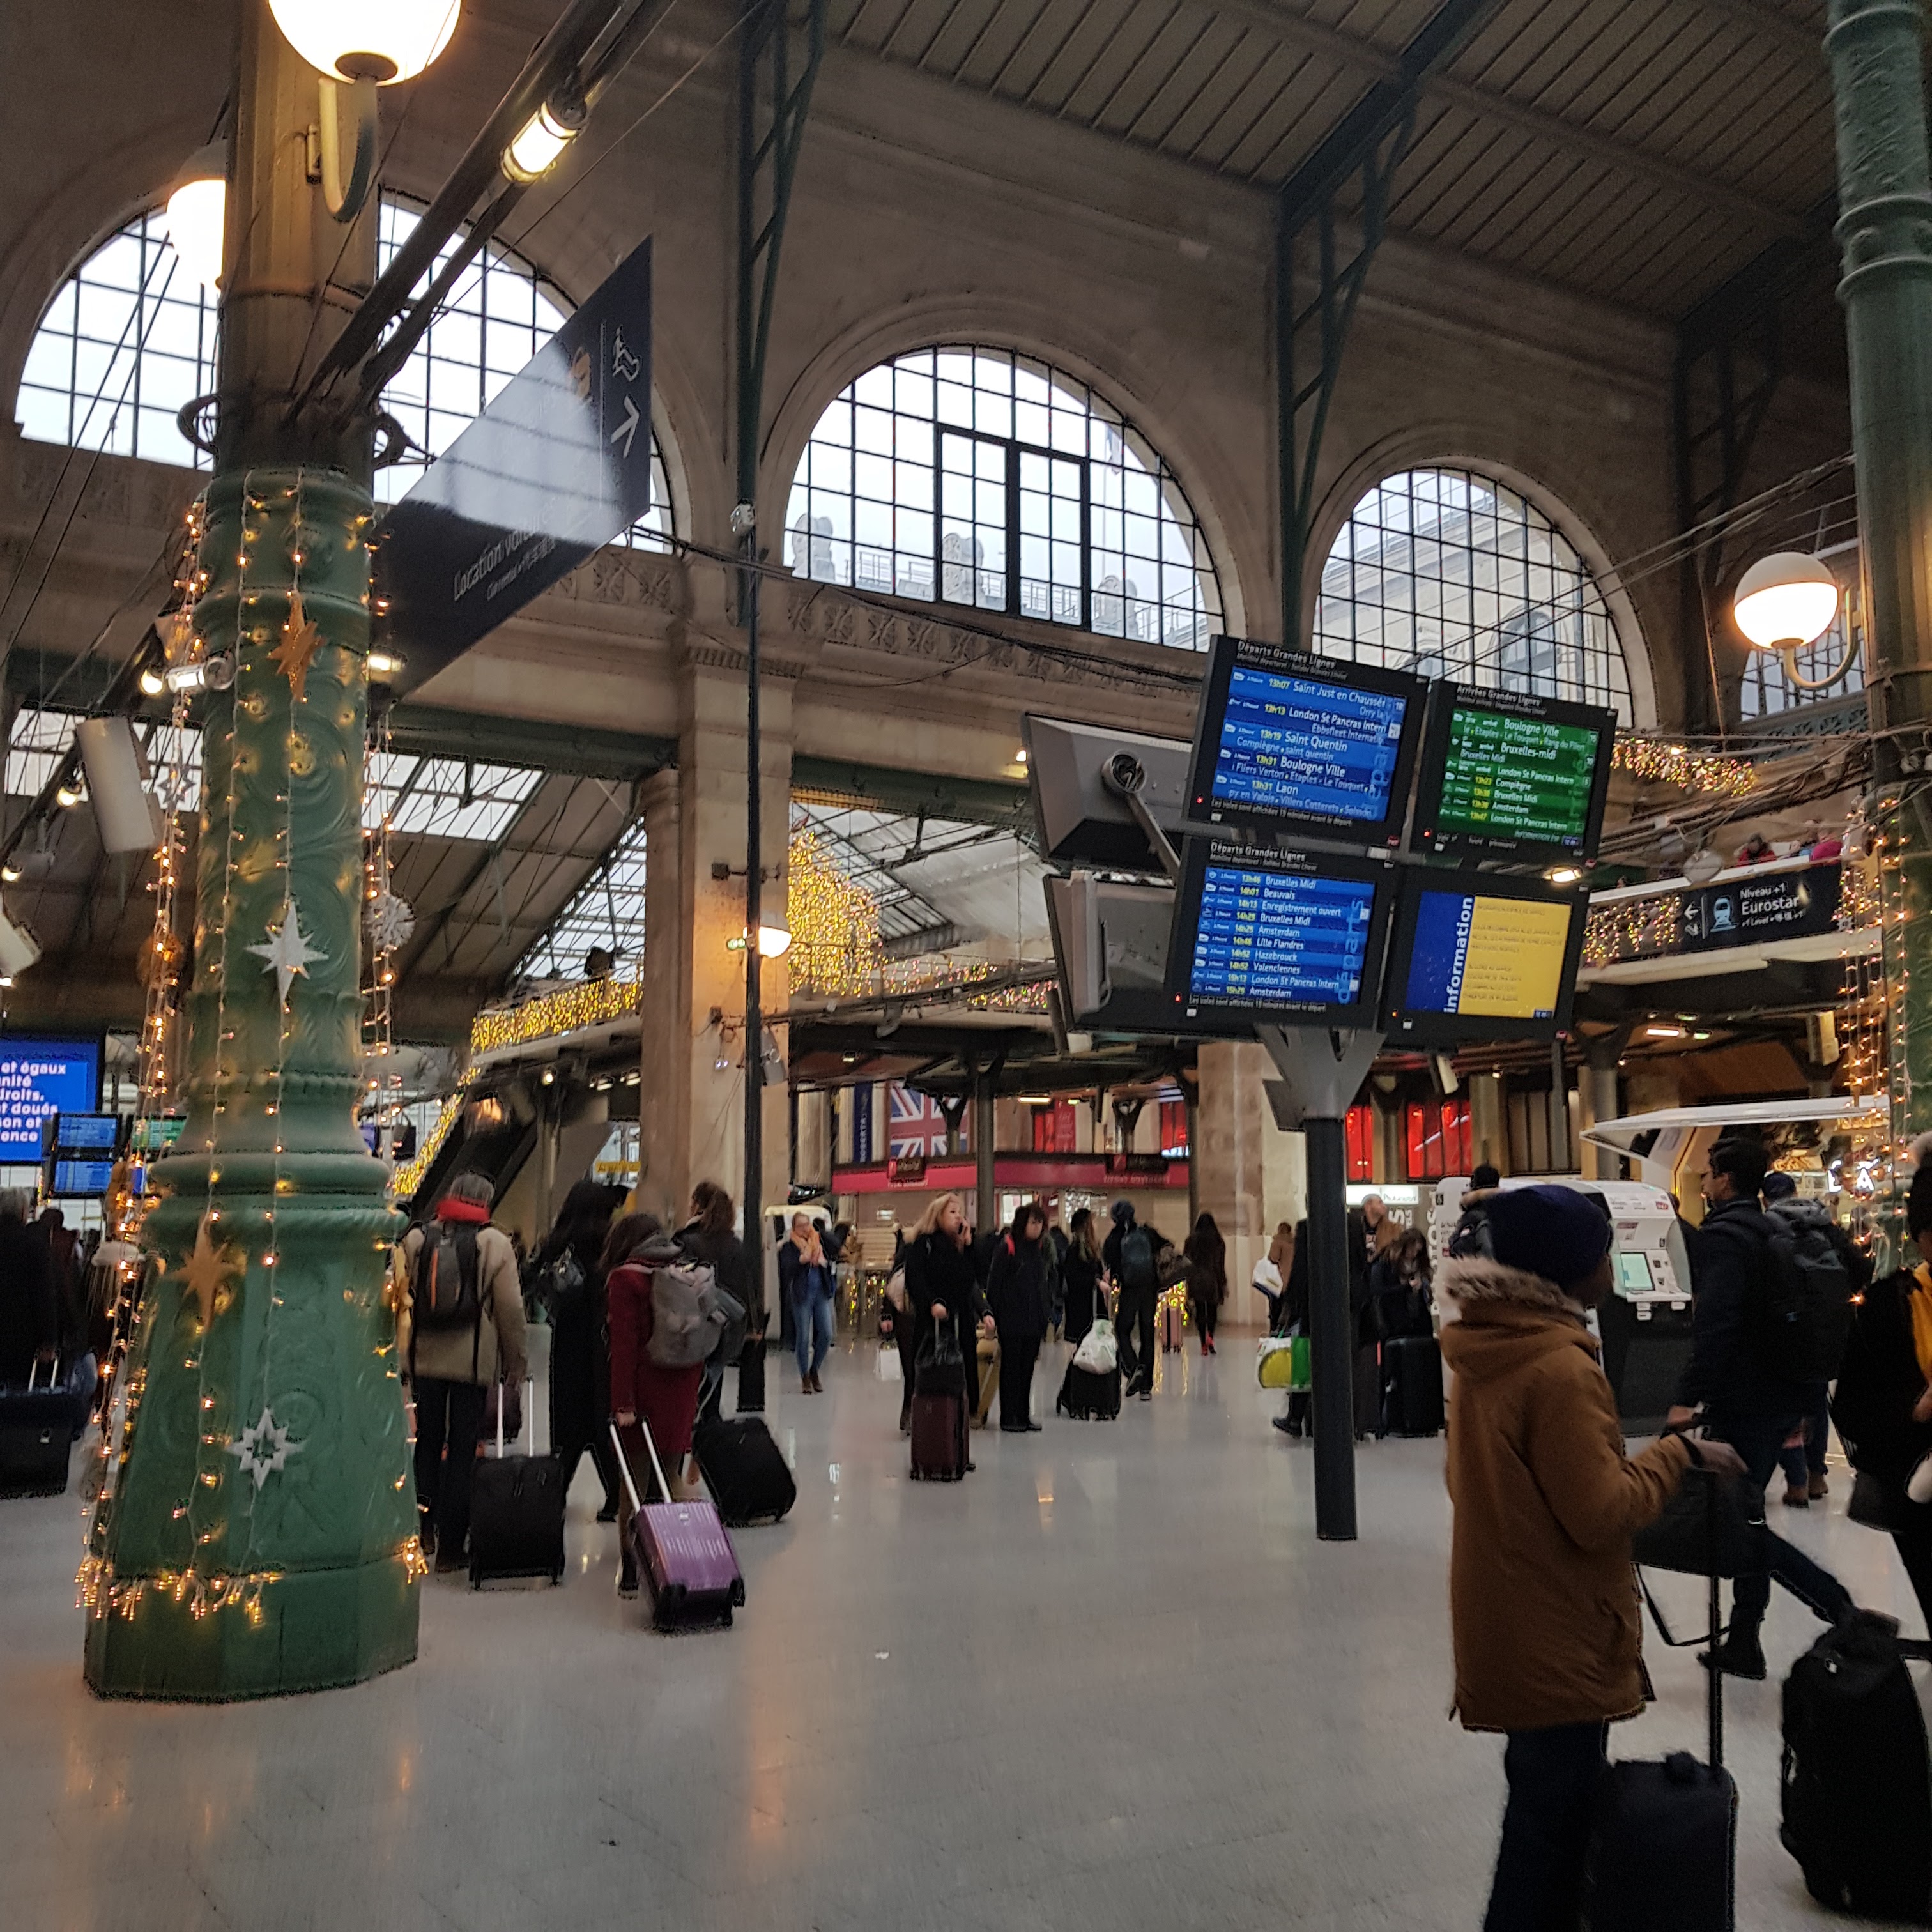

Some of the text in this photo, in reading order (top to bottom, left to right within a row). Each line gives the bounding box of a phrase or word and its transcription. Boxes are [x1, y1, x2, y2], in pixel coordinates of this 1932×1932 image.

[454, 540, 504, 601] Location
[1273, 648, 1307, 663] Grandes
[1310, 655, 1336, 669] Lignes
[1269, 678, 1291, 689] 13h07
[1294, 680, 1315, 694] Saint
[1317, 686, 1335, 698] Just
[1337, 691, 1347, 701] en
[1488, 689, 1516, 702] Grandes
[1289, 706, 1319, 721] London
[1321, 712, 1330, 723] St
[1331, 714, 1362, 729] Pancras
[1505, 718, 1540, 735] Boulogne
[1543, 724, 1559, 737] Ville
[1237, 737, 1280, 753] Compiègne
[1305, 749, 1334, 762] quentin
[1285, 731, 1308, 746] Saint
[1310, 736, 1347, 753] Quentin
[1501, 742, 1557, 760] Bruxelles-midi
[1256, 755, 1277, 766] 13h31
[1280, 756, 1324, 774] Boulogne
[1326, 763, 1346, 778] Ville
[1498, 765, 1521, 778] London
[1522, 769, 1529, 779] St
[1531, 770, 1554, 783] Pancras
[1259, 767, 1285, 779] Verton
[1291, 771, 1317, 785] Etaples
[1324, 777, 1333, 786] Le
[1335, 778, 1363, 792] Touquet
[1276, 781, 1298, 795] Laon
[1252, 791, 1275, 803] Valois
[1281, 796, 1303, 808] Villers
[1305, 799, 1339, 813] Cotterets
[1494, 790, 1522, 802] Bruxelles
[1492, 801, 1529, 814] Amsterdam
[1491, 812, 1515, 824] London
[1524, 818, 1547, 829] Pancras
[1211, 842, 1306, 862] Départs Grandes Lignes
[1266, 875, 1298, 888] Bruxelles
[1300, 879, 1316, 889] Midi
[1264, 888, 1295, 901] Beauvais
[1740, 882, 1785, 900] Niveau +1
[1262, 900, 1317, 916] Enregistrement
[1318, 907, 1341, 917] ouvert
[1742, 896, 1799, 916] Eurostar
[1261, 913, 1293, 925] Bruxelles
[1294, 916, 1310, 926] Midi
[1258, 924, 1300, 937] Amsterdam
[1257, 937, 1272, 947] Lille
[1273, 939, 1304, 950] Flandres
[1255, 949, 1297, 962] Hazebrouck
[1443, 896, 1473, 1013] information
[1254, 962, 1300, 975] Valenciennes
[1252, 974, 1278, 985] London
[1280, 977, 1287, 985] St
[1289, 978, 1317, 988] Pancras
[1249, 986, 1291, 998] Amsterdam
[20, 1061, 66, 1077] égaux
[0, 1074, 32, 1087] nité
[0, 1117, 22, 1129] on
[0, 1130, 38, 1142] ence
